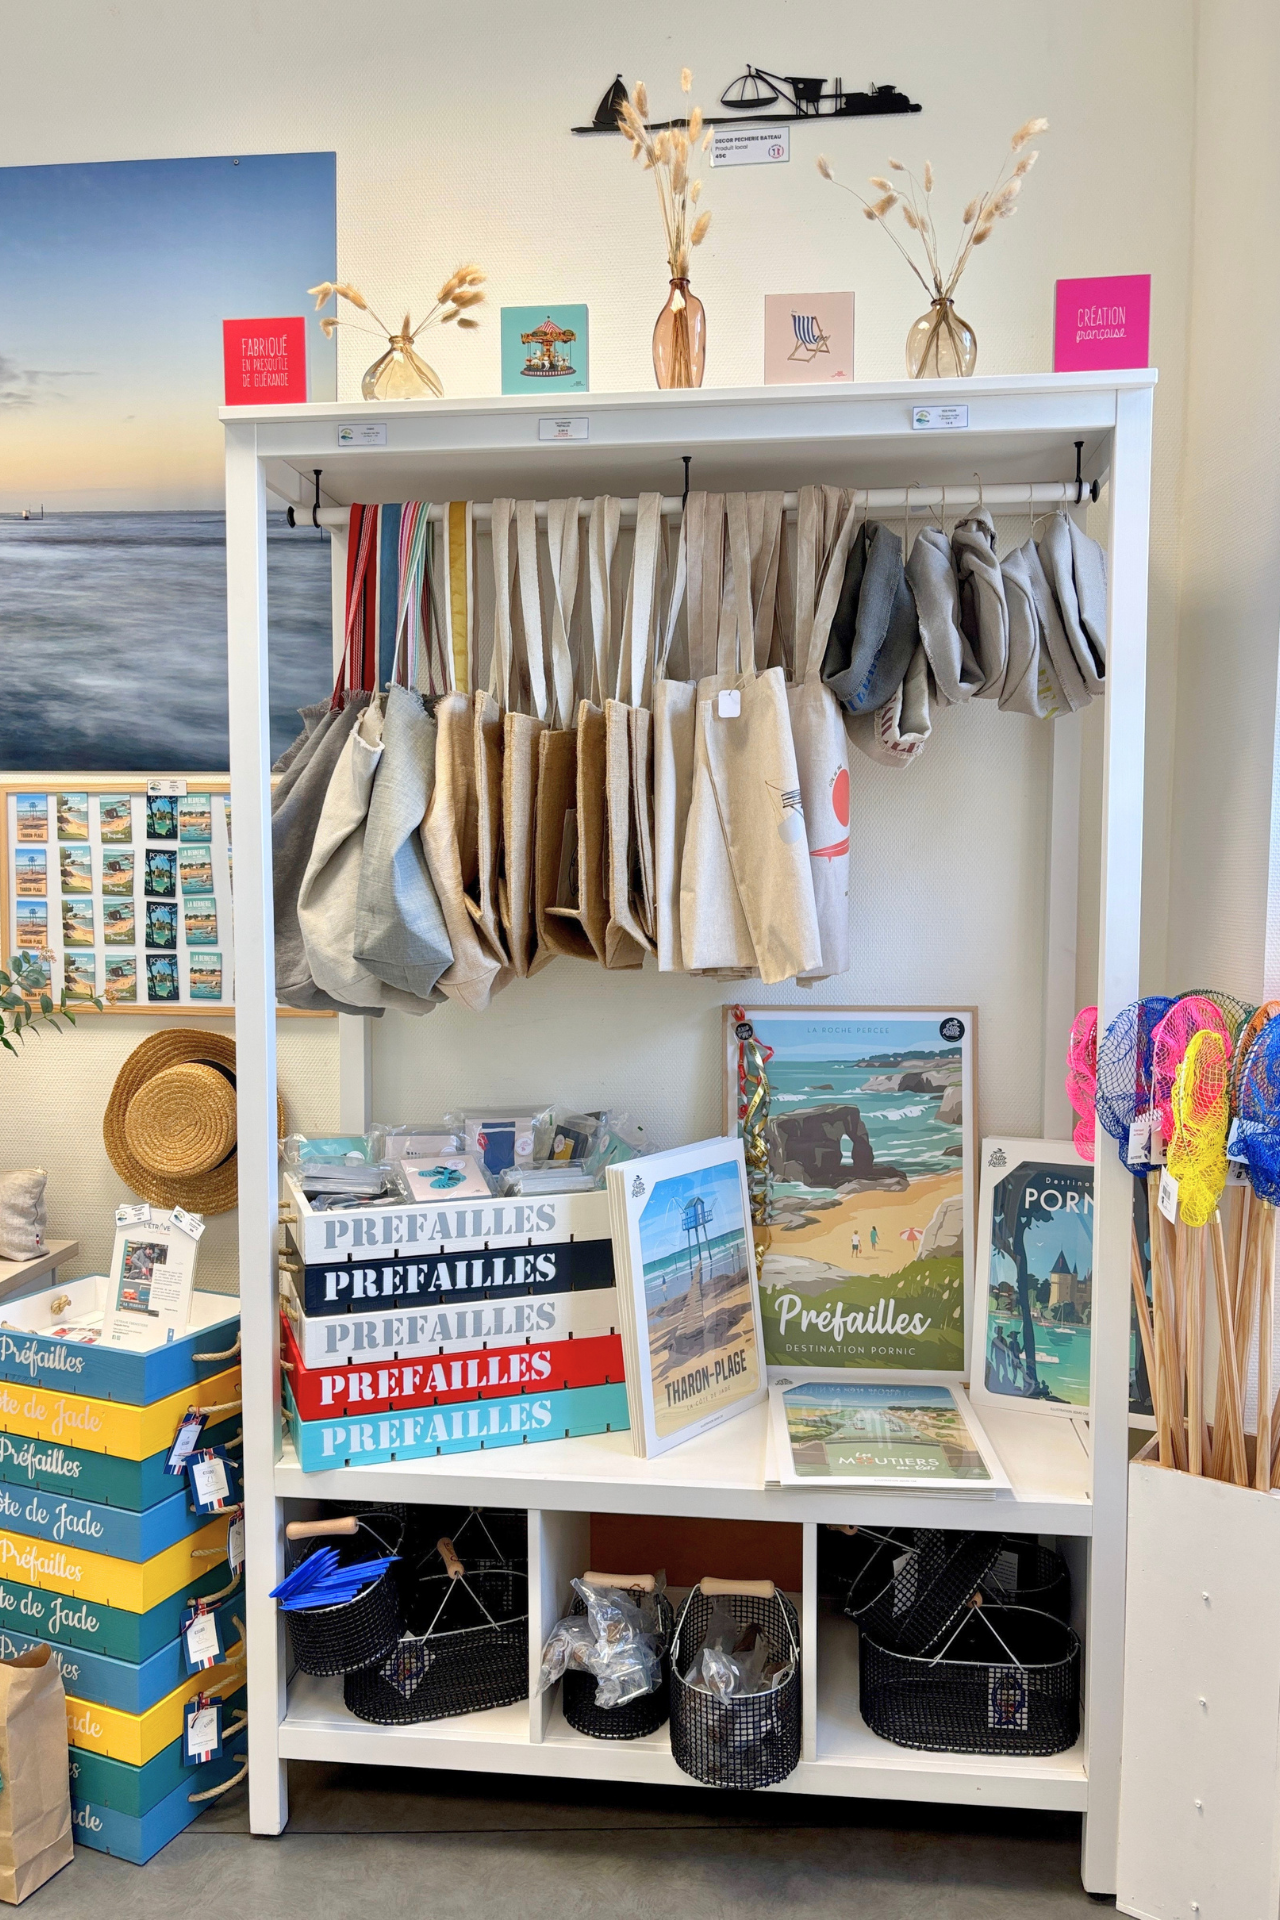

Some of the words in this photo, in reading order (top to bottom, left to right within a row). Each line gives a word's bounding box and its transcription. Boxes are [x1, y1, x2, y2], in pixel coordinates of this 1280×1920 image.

[1076, 327, 1127, 344] française
[1077, 305, 1126, 328] CRÉATION
[241, 334, 288, 358] FABRIQUÉ
[242, 359, 251, 372] EN
[242, 373, 251, 388] DE
[254, 371, 289, 388] GUÉRANDE
[856, 1027, 890, 1035] PERCEE
[1024, 1188, 1094, 1214] PORN
[1045, 1177, 1094, 1187] Destina
[323, 1203, 556, 1250] PREFAILLES
[324, 1253, 557, 1301] PREFAILLES
[325, 1301, 556, 1354] PREFAILLES
[774, 1294, 932, 1342] Préfailles
[0, 1335, 85, 1378] Préfailles
[785, 1343, 865, 1354] DESTINATION
[871, 1346, 916, 1356] PORNIC
[319, 1350, 552, 1406] PREFAILLES
[665, 1348, 747, 1408] THARON-PLAGE
[710, 1391, 717, 1399] DE
[719, 1385, 731, 1396] JADE
[24, 1393, 48, 1420] de
[51, 1398, 102, 1436] Jade
[321, 1399, 552, 1457] PREFAILLES
[0, 1436, 82, 1480] Préfailles
[838, 1457, 940, 1466] MOUTIERS
[25, 1497, 50, 1524] de
[53, 1503, 104, 1540] Jade
[0, 1538, 84, 1582] Préfailles
[20, 1591, 45, 1617] de
[48, 1597, 100, 1634] Jade
[66, 1711, 103, 1738] ade
